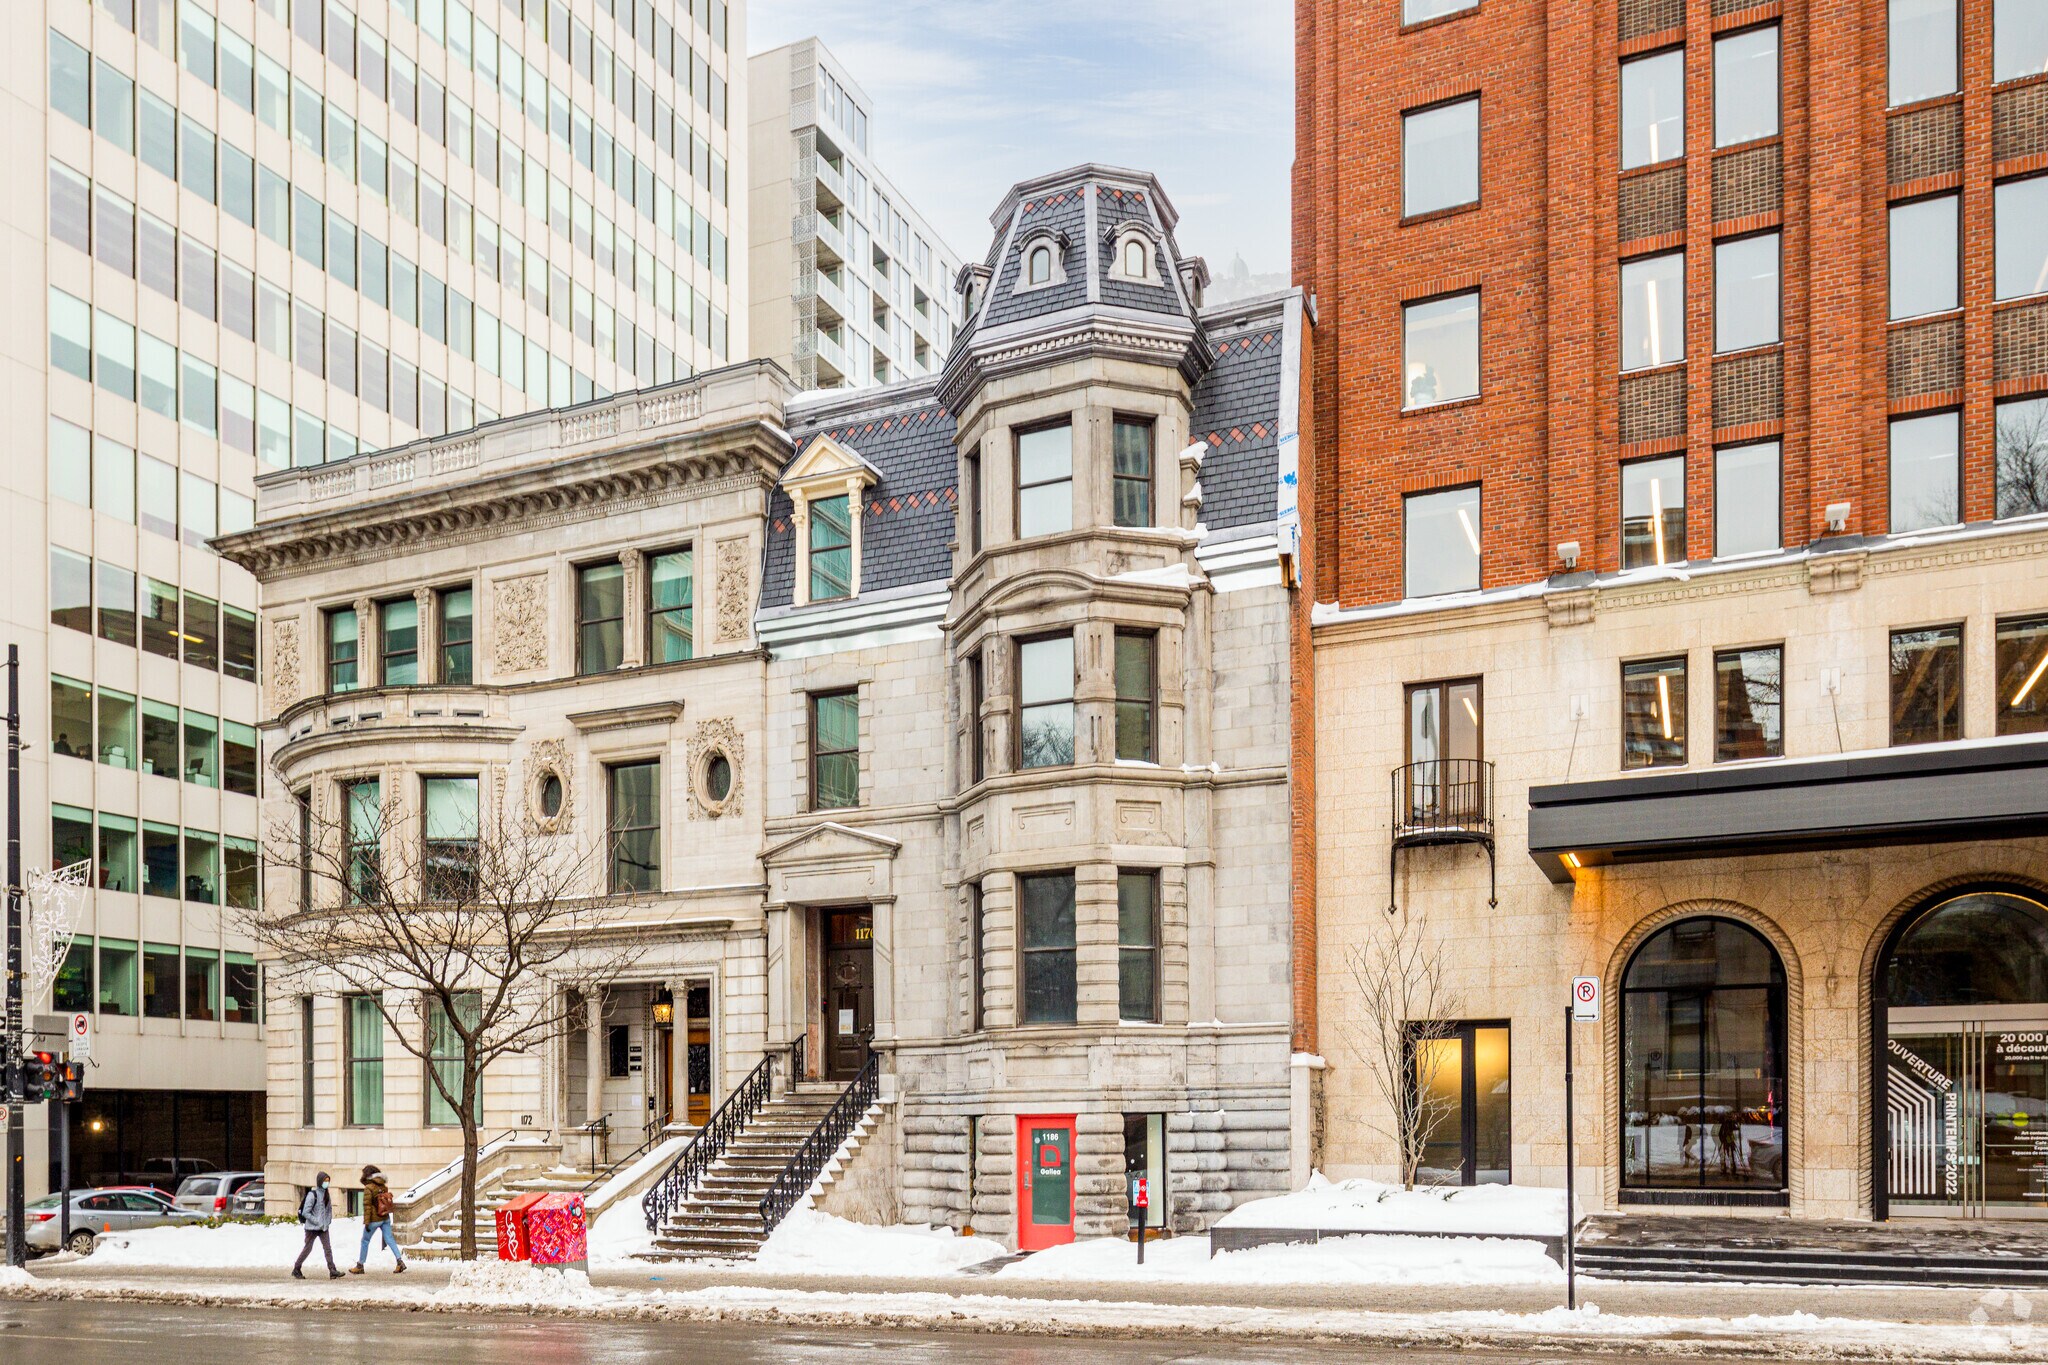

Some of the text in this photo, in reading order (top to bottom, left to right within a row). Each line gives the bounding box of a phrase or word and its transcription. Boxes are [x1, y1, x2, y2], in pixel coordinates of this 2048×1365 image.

[1582, 985, 1591, 998] P
[2000, 1033, 2016, 1043] 20
[2018, 1033, 2044, 1043] 000
[1996, 1043, 2004, 1053] à
[1888, 1039, 1953, 1090] OUVERTURE
[1042, 1133, 1059, 1141] 1186
[1946, 1092, 1958, 1195] PRINTEMPS 2022
